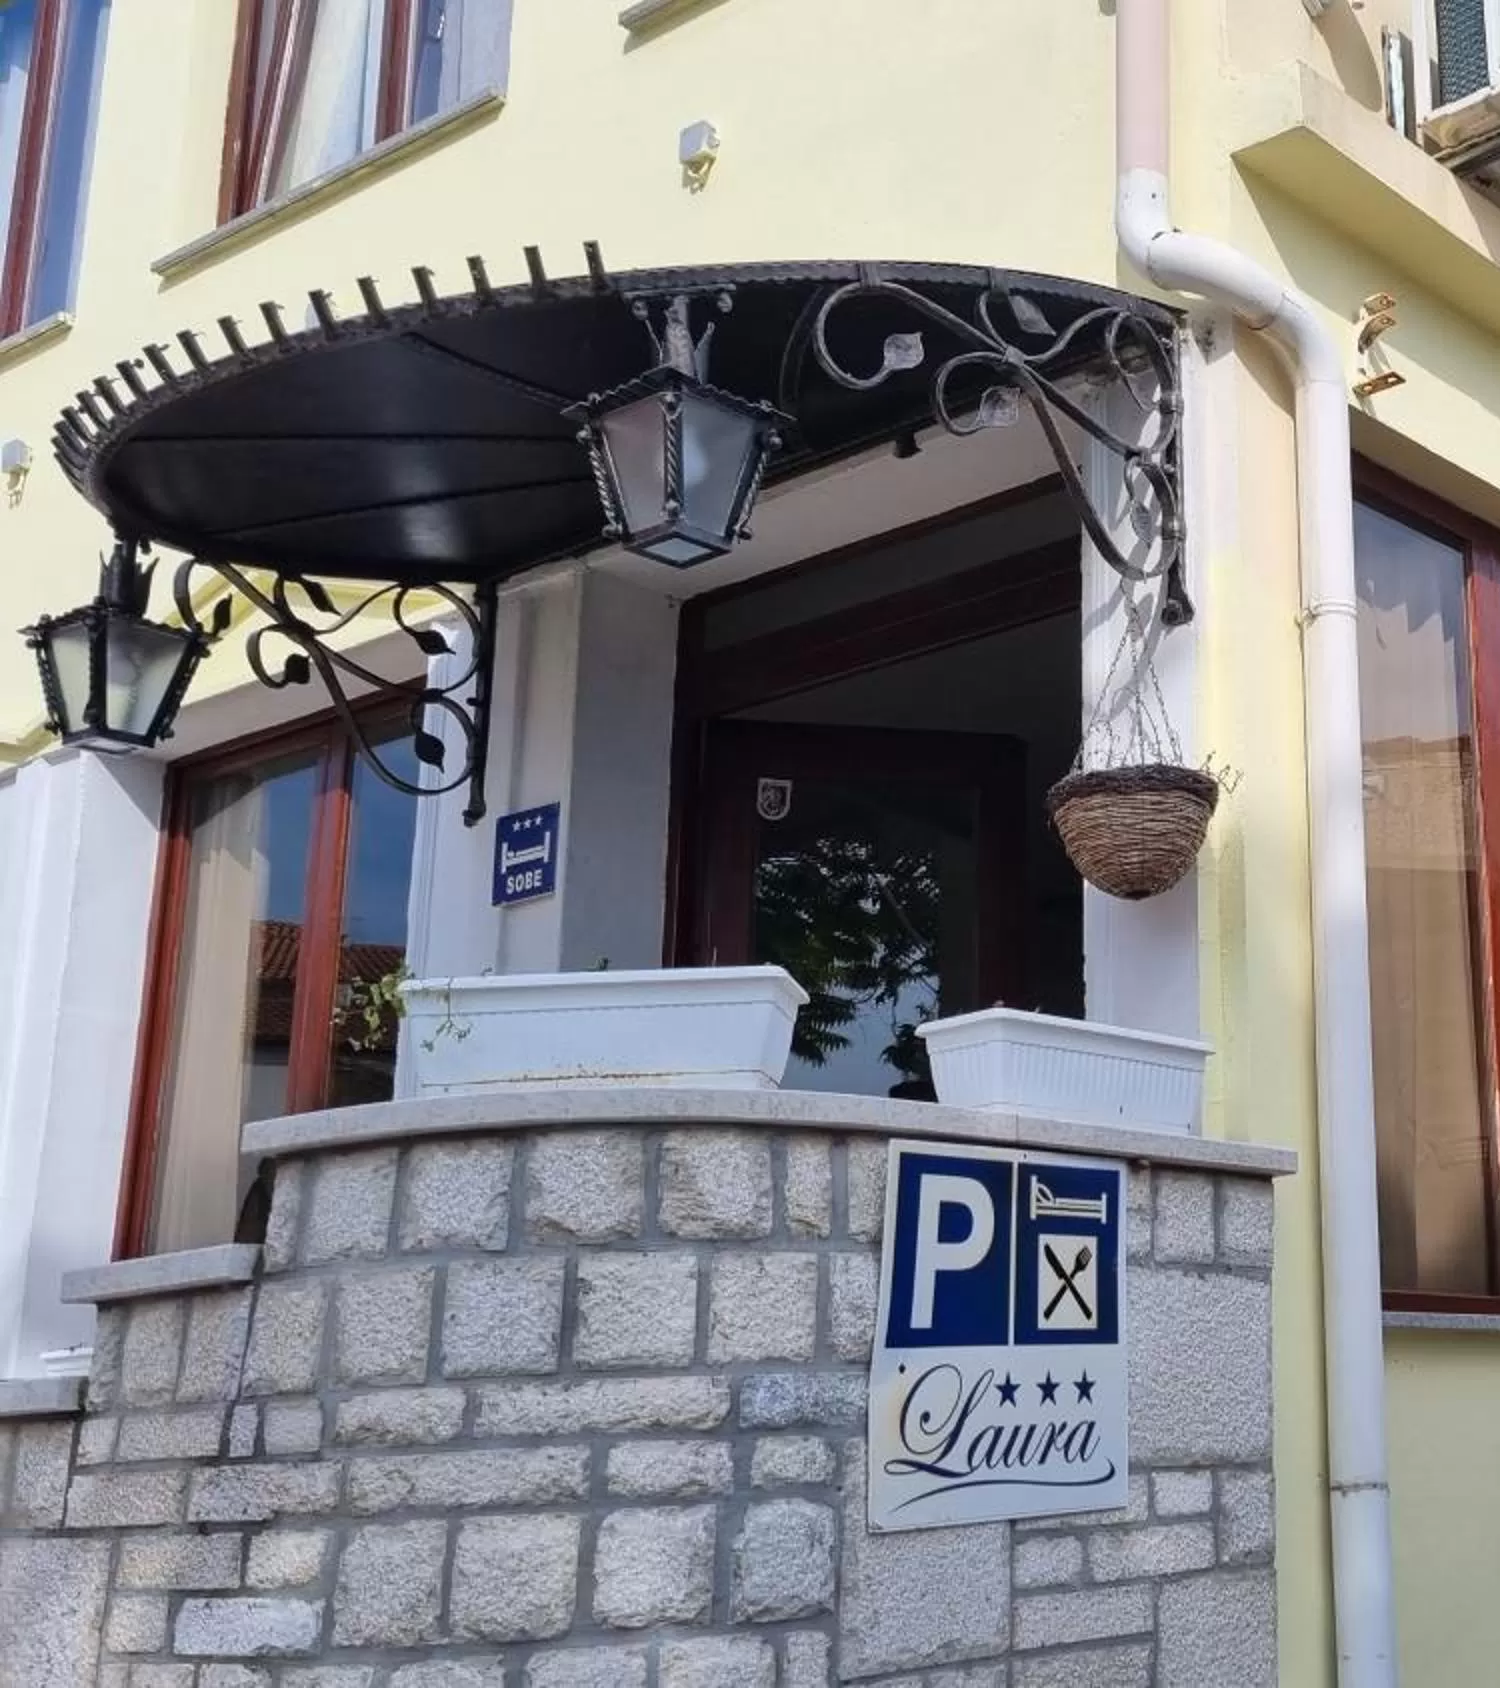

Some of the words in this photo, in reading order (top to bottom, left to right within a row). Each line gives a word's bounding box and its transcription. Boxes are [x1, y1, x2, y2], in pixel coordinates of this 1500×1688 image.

[506, 869, 542, 895] SOBE
[910, 1173, 995, 1329] P
[884, 1363, 1101, 1478] Laura
